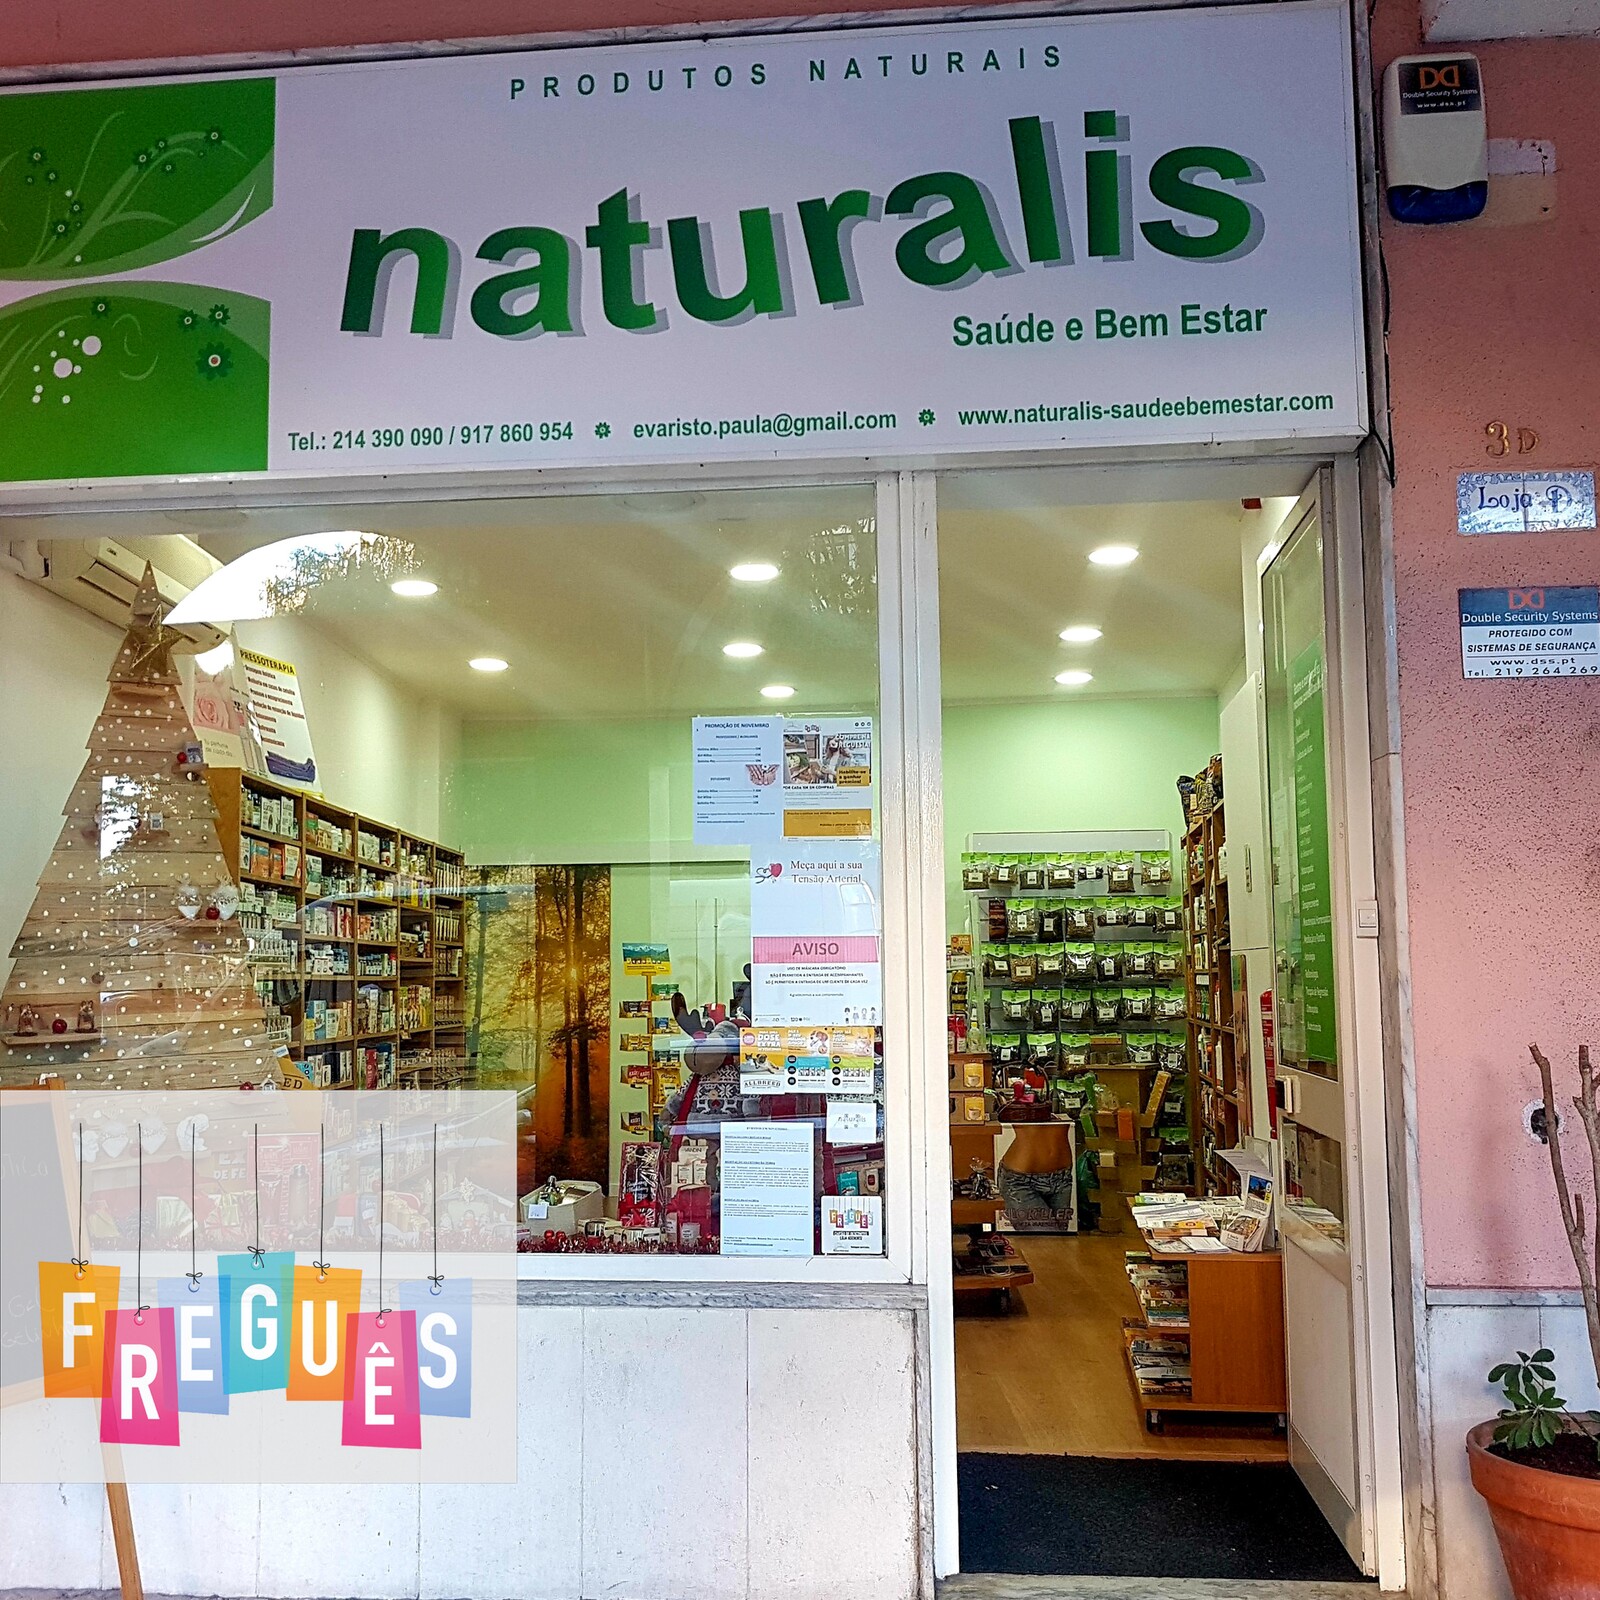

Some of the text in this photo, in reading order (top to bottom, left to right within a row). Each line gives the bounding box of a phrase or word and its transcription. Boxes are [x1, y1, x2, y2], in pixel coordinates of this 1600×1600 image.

[510, 45, 1062, 101] PRODUTOS NATURAIS
[1402, 88, 1478, 99] Double Security Systems
[340, 110, 1265, 340] naturalis
[953, 304, 1268, 347] Saúde e Bem Estar
[958, 391, 1335, 426] www.naturalis-saudeebemestar.com
[632, 408, 897, 441] evaristo.paula@gmail.com
[287, 422, 574, 452] Tel.: 214 390 090 / 917 860 954
[1478, 486, 1532, 513] Loja
[1462, 611, 1598, 623] Double Security Systems
[1489, 628, 1573, 638] PROTEGIDO COM
[1467, 642, 1596, 652] SISTEMAS DE SEGURANÇA
[240, 650, 295, 675] PRESSOTERAPIA
[1490, 657, 1576, 666] www.dss.pt
[1532, 667, 1561, 675] 264
[1569, 666, 1598, 674] 269
[704, 722, 732, 730] PROMOÇÃO
[790, 860, 815, 871] Meça
[817, 860, 837, 871] aqui
[791, 874, 862, 883] Tensão Arterial
[792, 942, 840, 956] AVISO
